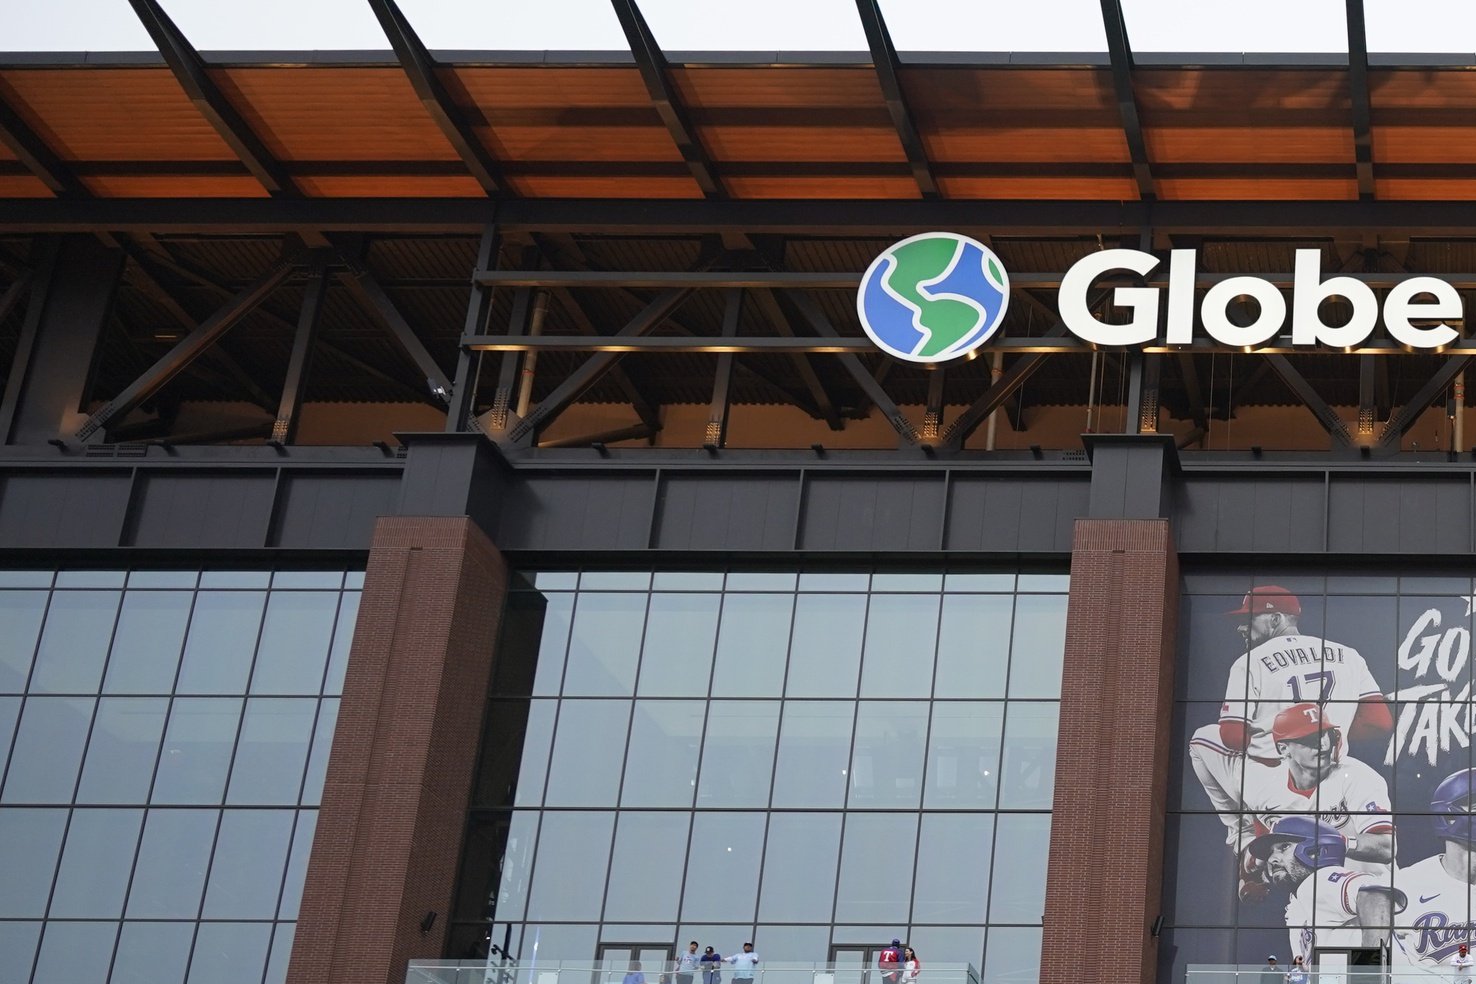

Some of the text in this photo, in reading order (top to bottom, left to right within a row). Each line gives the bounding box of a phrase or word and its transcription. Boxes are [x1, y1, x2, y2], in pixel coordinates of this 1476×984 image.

[1058, 248, 1463, 349] Globe
[1261, 647, 1344, 673] EOVALDI
[1397, 607, 1470, 682] GO
[1286, 670, 1336, 708] 17
